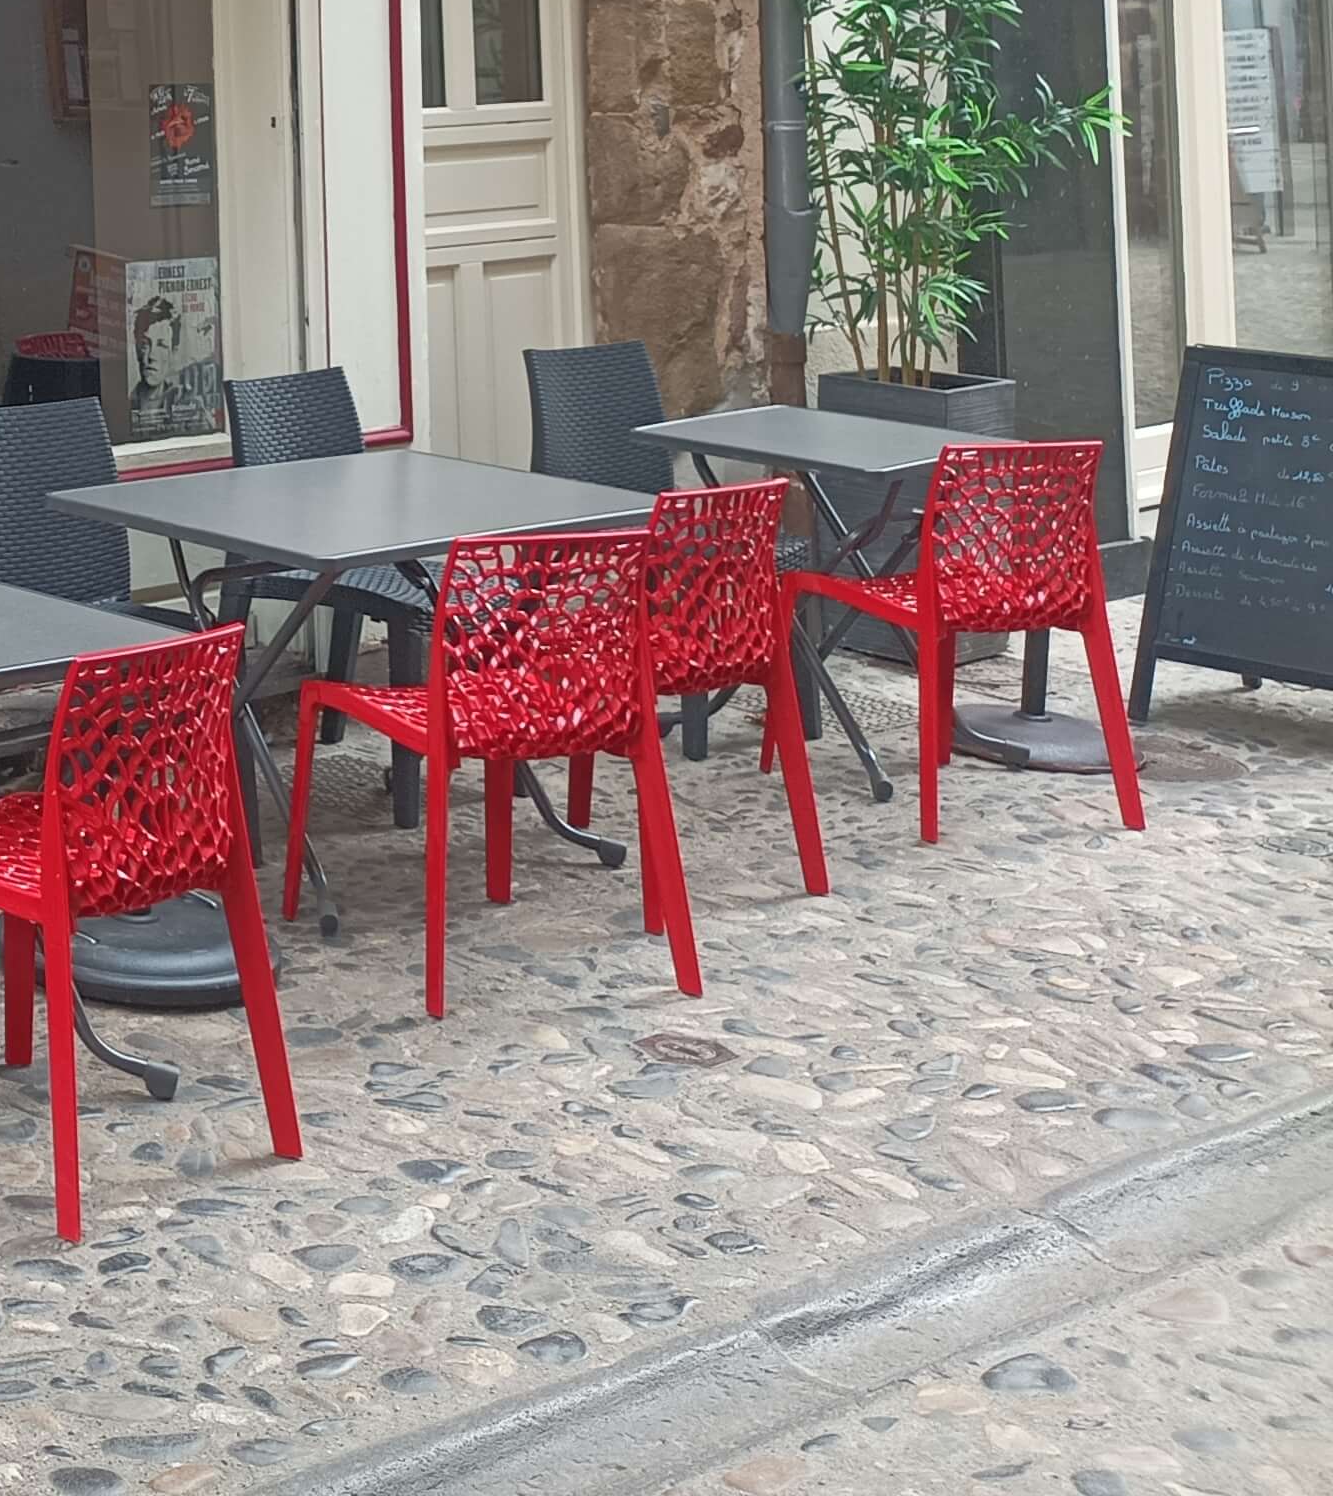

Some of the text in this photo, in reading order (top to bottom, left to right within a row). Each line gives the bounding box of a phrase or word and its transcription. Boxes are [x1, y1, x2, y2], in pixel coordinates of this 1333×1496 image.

[1205, 367, 1253, 392] Pizza
[1202, 420, 1246, 442] Salade
[1195, 454, 1229, 475] Pâtes
